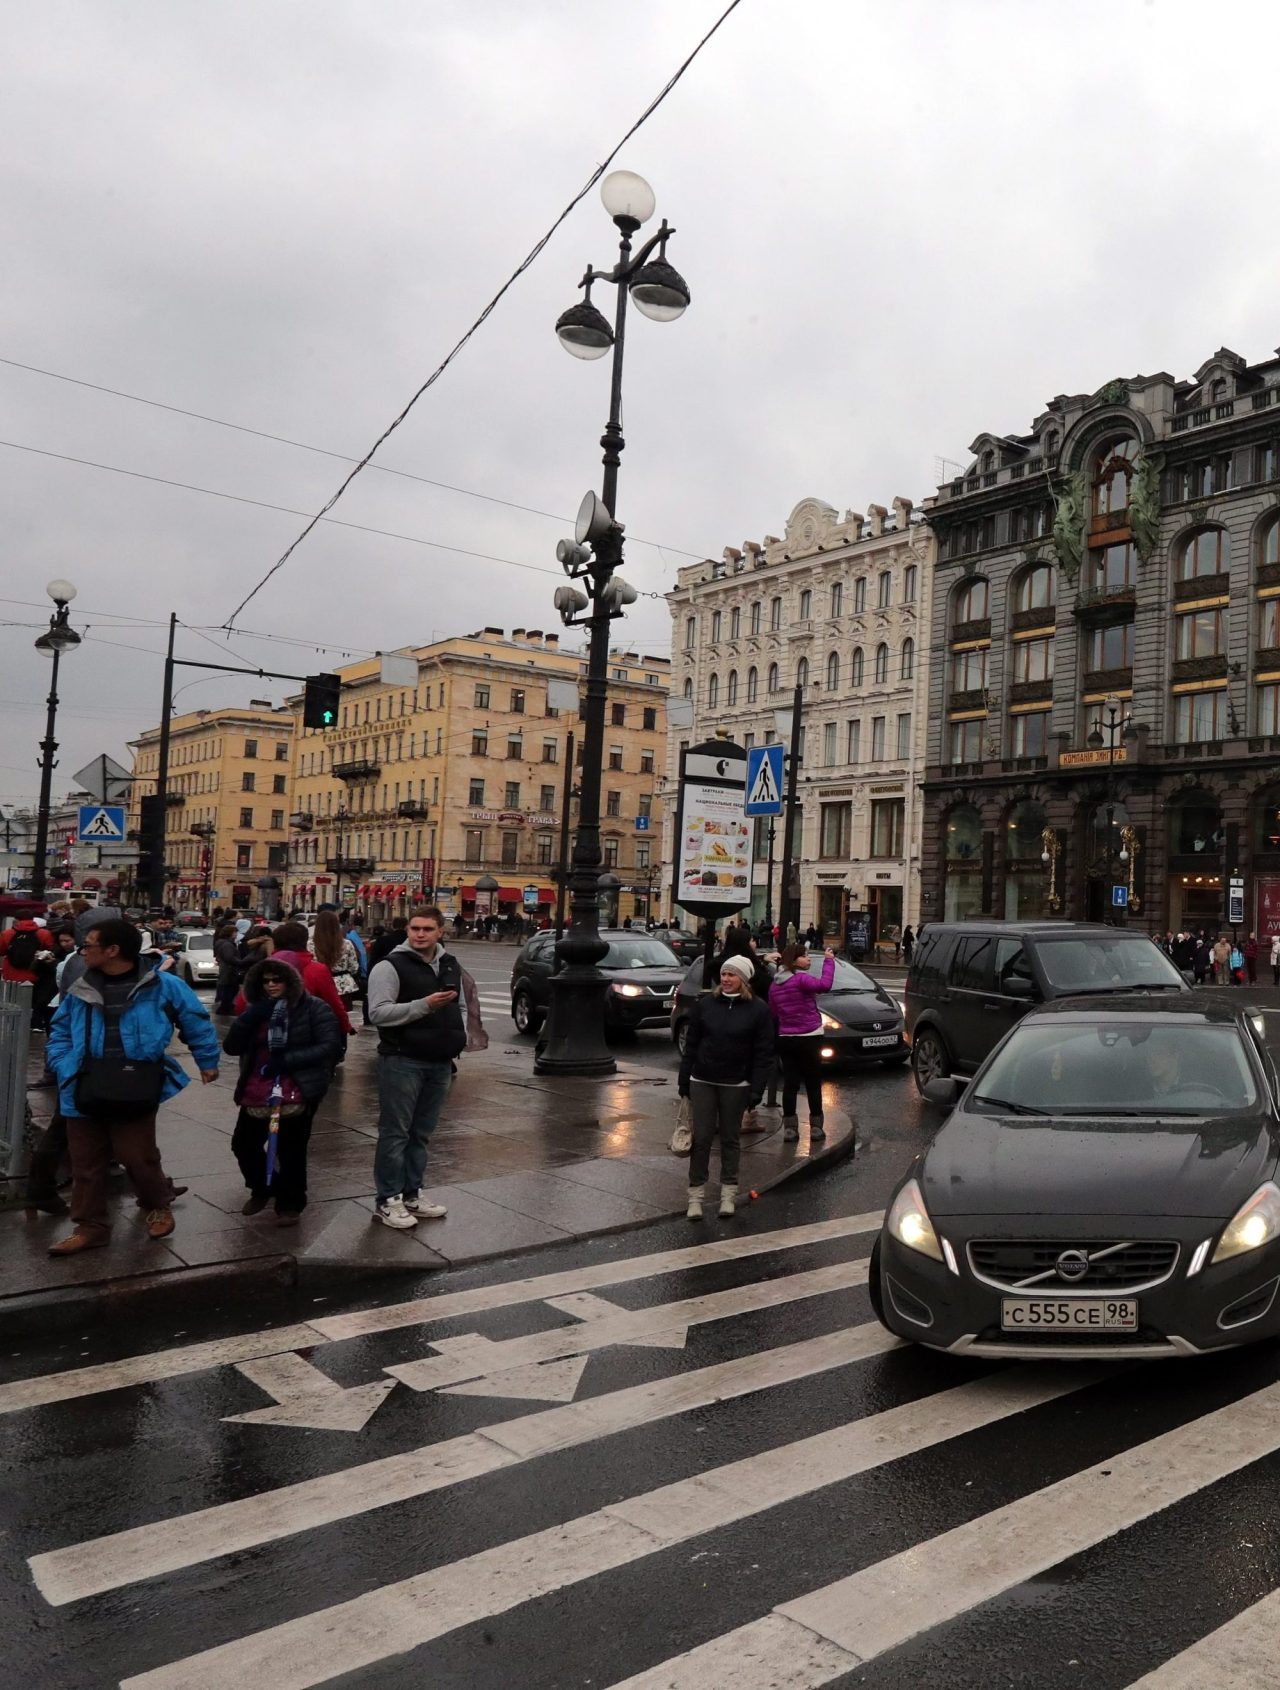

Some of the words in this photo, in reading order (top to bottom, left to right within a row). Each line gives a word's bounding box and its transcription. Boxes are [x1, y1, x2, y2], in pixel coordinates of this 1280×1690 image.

[1063, 751, 1094, 764] КОМПАНІЯ
[1095, 749, 1125, 762] ЗИНГРЪ.
[1107, 1303, 1129, 1318] 98
